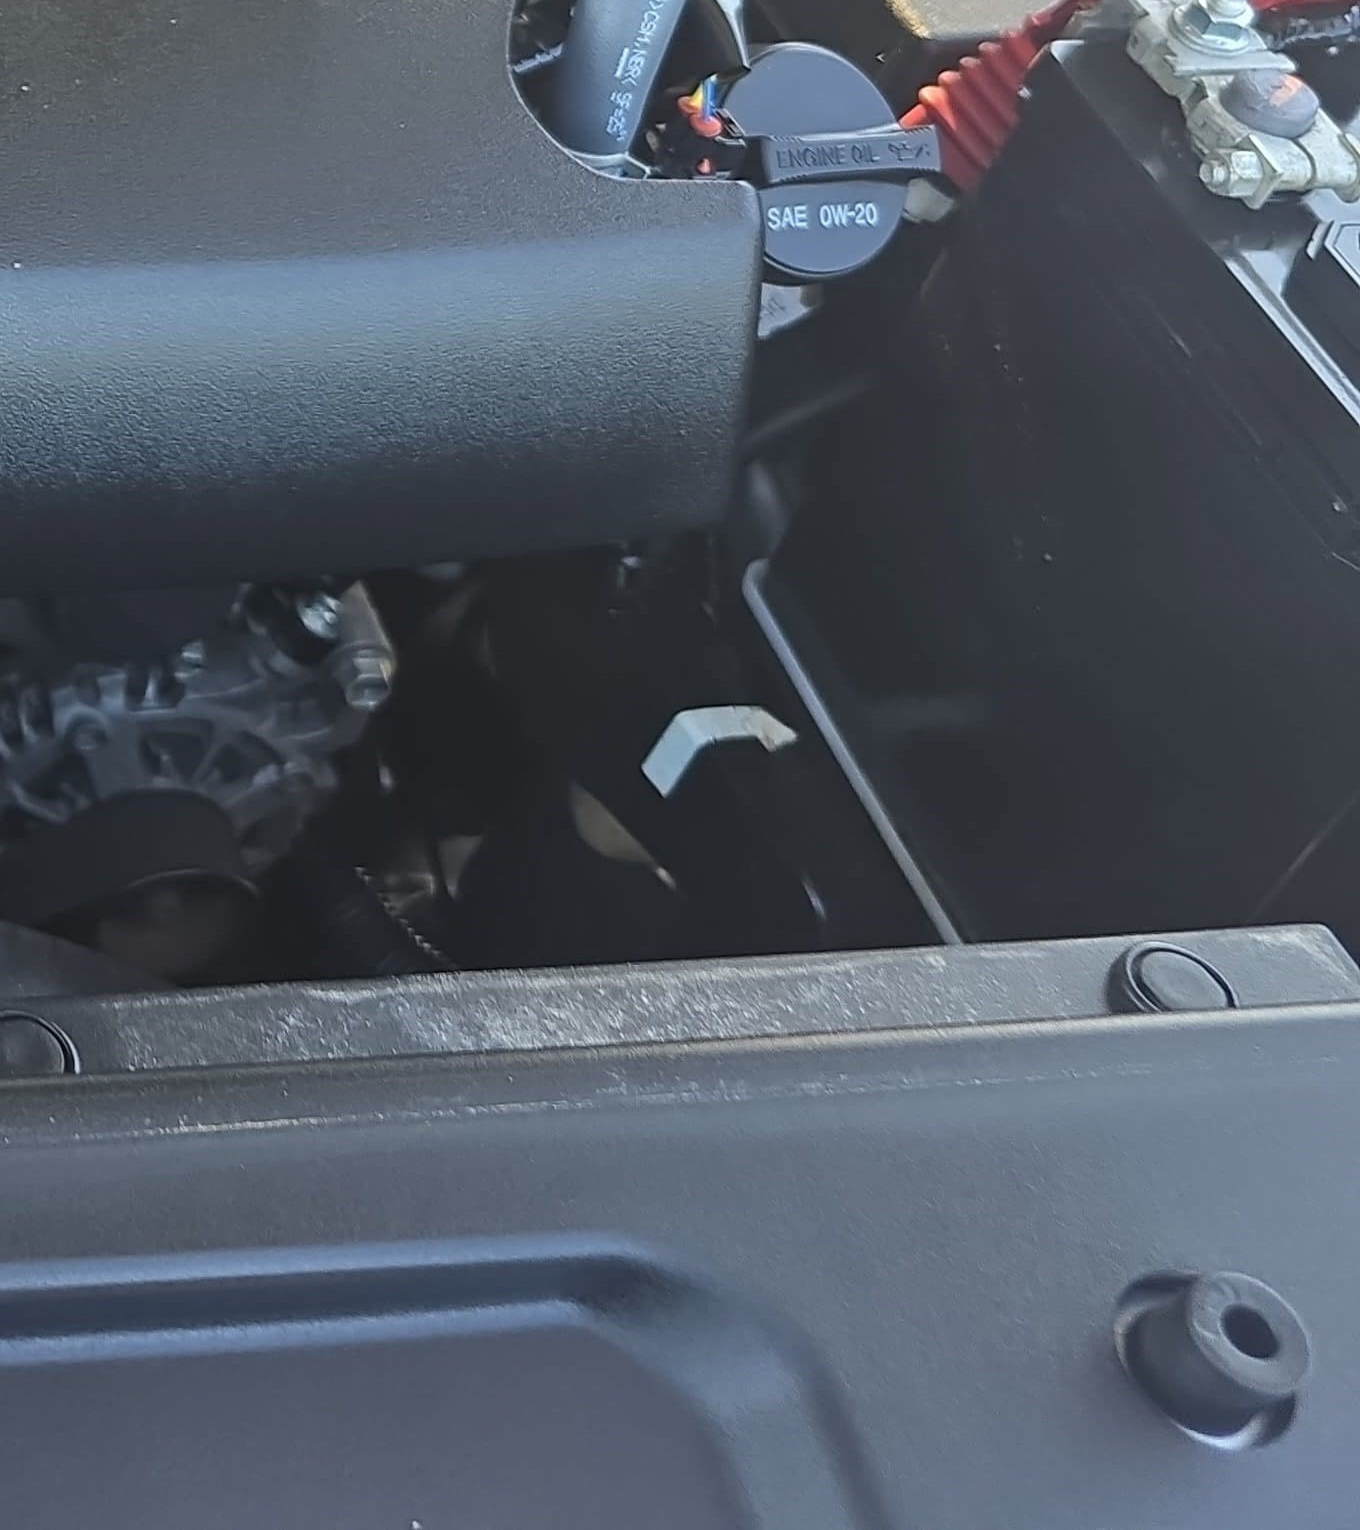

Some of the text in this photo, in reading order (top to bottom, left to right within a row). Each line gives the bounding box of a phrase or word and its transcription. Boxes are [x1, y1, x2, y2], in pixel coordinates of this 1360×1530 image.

[774, 141, 881, 169] ENGINE OIL
[767, 202, 879, 231] SAE 0W-20
